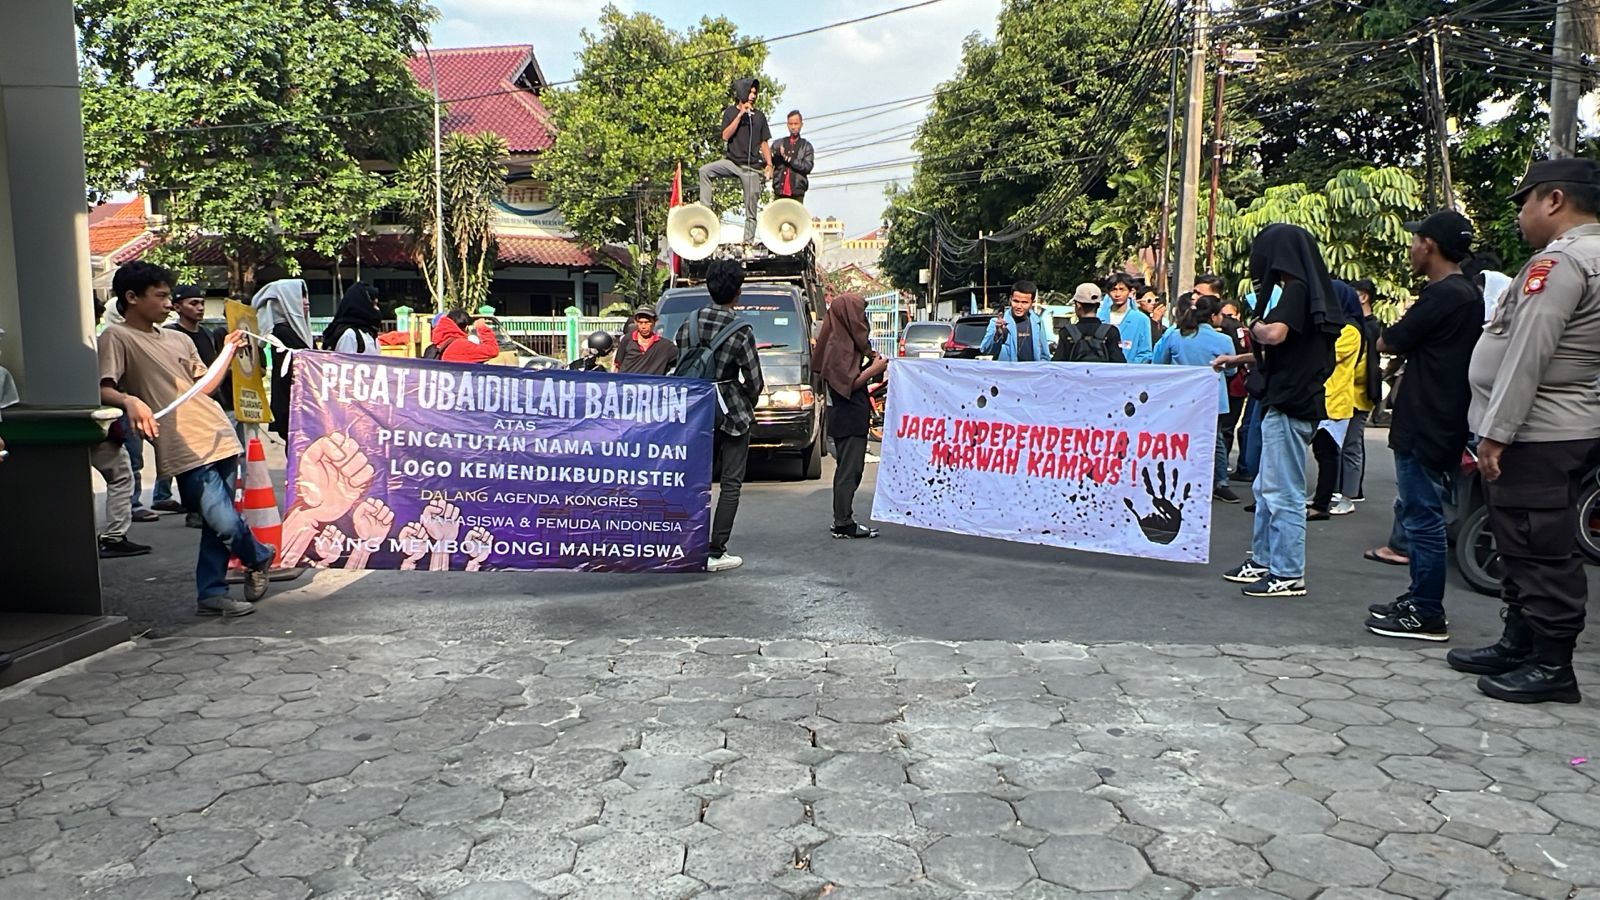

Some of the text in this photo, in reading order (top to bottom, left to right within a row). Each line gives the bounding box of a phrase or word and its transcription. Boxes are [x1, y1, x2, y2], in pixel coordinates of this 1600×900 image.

[322, 363, 687, 424] PEGAT UBAIDILLAH BADRUN
[494, 419, 536, 431] ATAS
[897, 415, 1190, 461] JAGA INDEPENDENCIA DAN
[378, 430, 687, 460] PENCATUTAN NAMA UNJ DAN
[391, 459, 685, 487] LOGO KEMENDIKBUDRISTEK
[931, 441, 1020, 475] MARWAH
[1026, 452, 1121, 486] KAMPUS
[421, 489, 638, 508] DALANG AGENDA KONGRES
[520, 517, 530, 527] &
[536, 517, 601, 530] PEMUDA
[606, 519, 681, 532] INDONESIA
[314, 536, 684, 558] YANG MEMBOHONGI MAHASISWA
